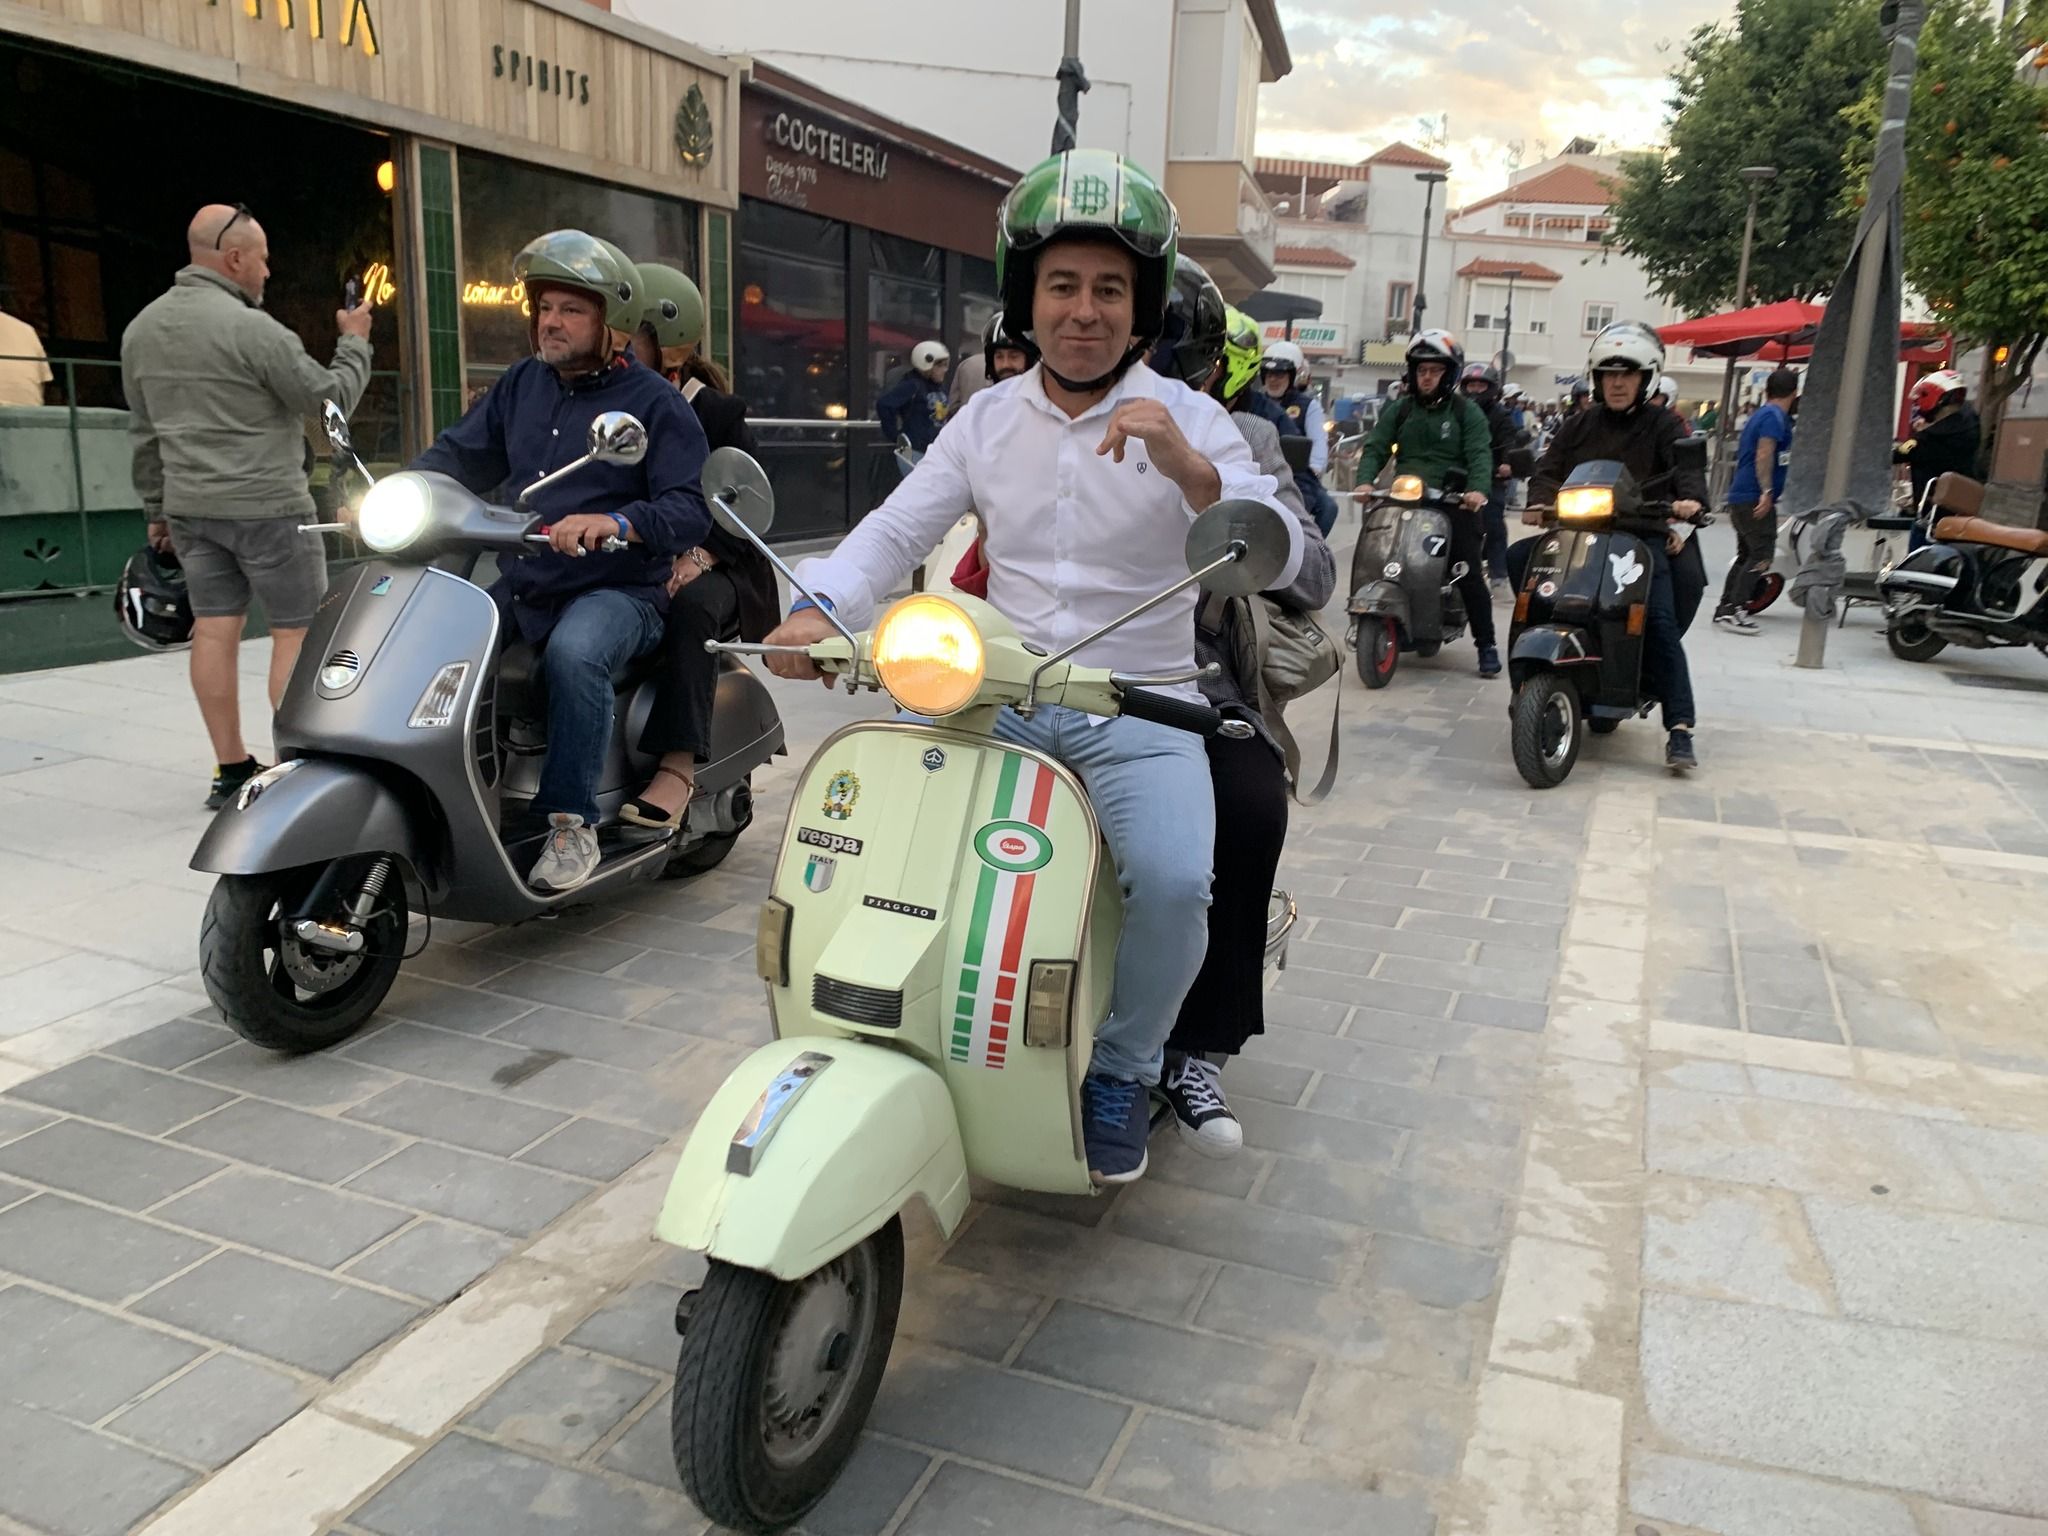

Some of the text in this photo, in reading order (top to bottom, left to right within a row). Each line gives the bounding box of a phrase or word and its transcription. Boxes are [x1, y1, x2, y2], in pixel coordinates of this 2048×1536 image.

[493, 44, 589, 105] SPIRITS
[1430, 536, 1446, 556] 7
[799, 828, 860, 854] vespa
[809, 854, 834, 865] ITALY
[868, 898, 929, 917] PIAGGIO
